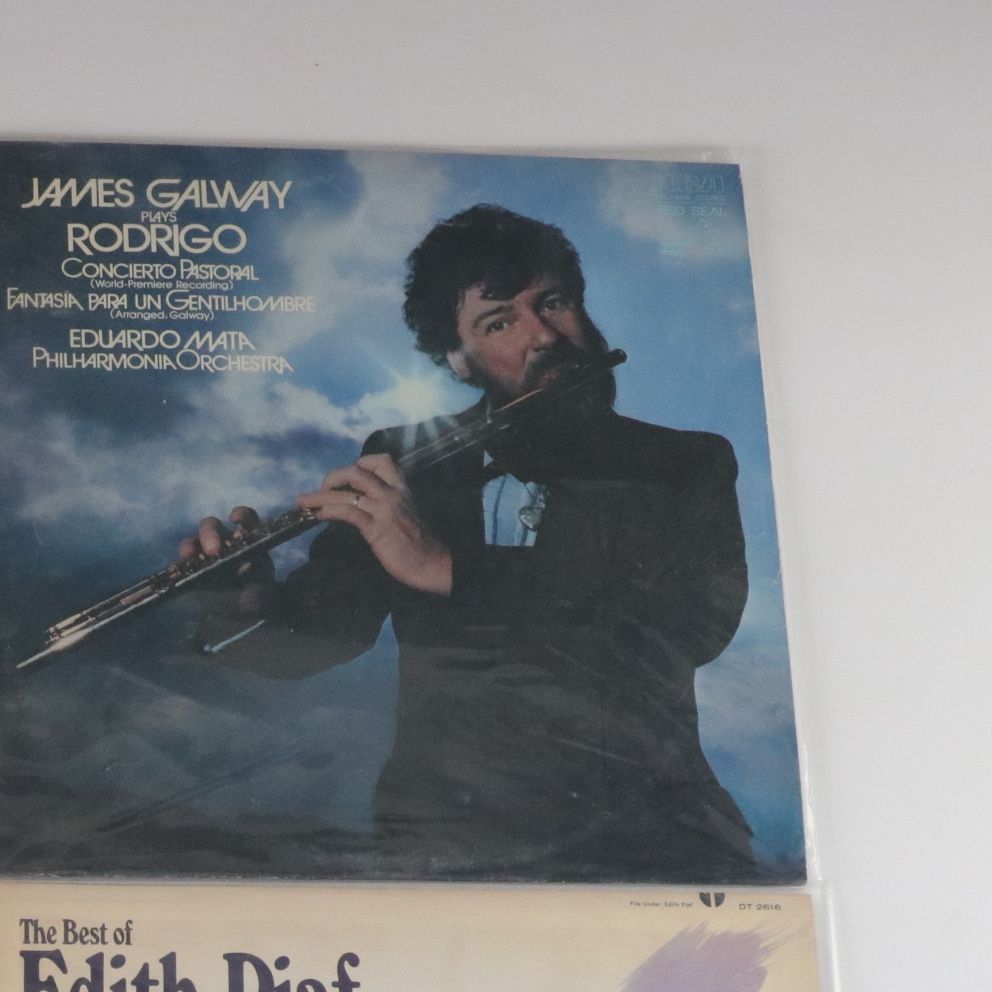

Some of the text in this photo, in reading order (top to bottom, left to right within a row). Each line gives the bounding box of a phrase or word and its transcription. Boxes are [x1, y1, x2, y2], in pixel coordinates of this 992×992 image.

[21, 177, 293, 212] JAMES GALWAY
[140, 210, 177, 223] PLAYS
[66, 222, 247, 256] RODRIGO
[60, 257, 260, 281] CONCIERTO PASTORAL
[90, 279, 234, 291] (World-Premiere Recording)
[88, 292, 128, 312] PARA
[134, 294, 162, 310] UN
[165, 290, 316, 312] GENTILHOMBRE
[169, 310, 215, 322] Galway)
[70, 328, 256, 351] EDUARDO MATA
[32, 346, 294, 374] PHILHARMONIA ORCHESTRA
[18, 918, 134, 946] The Best of
